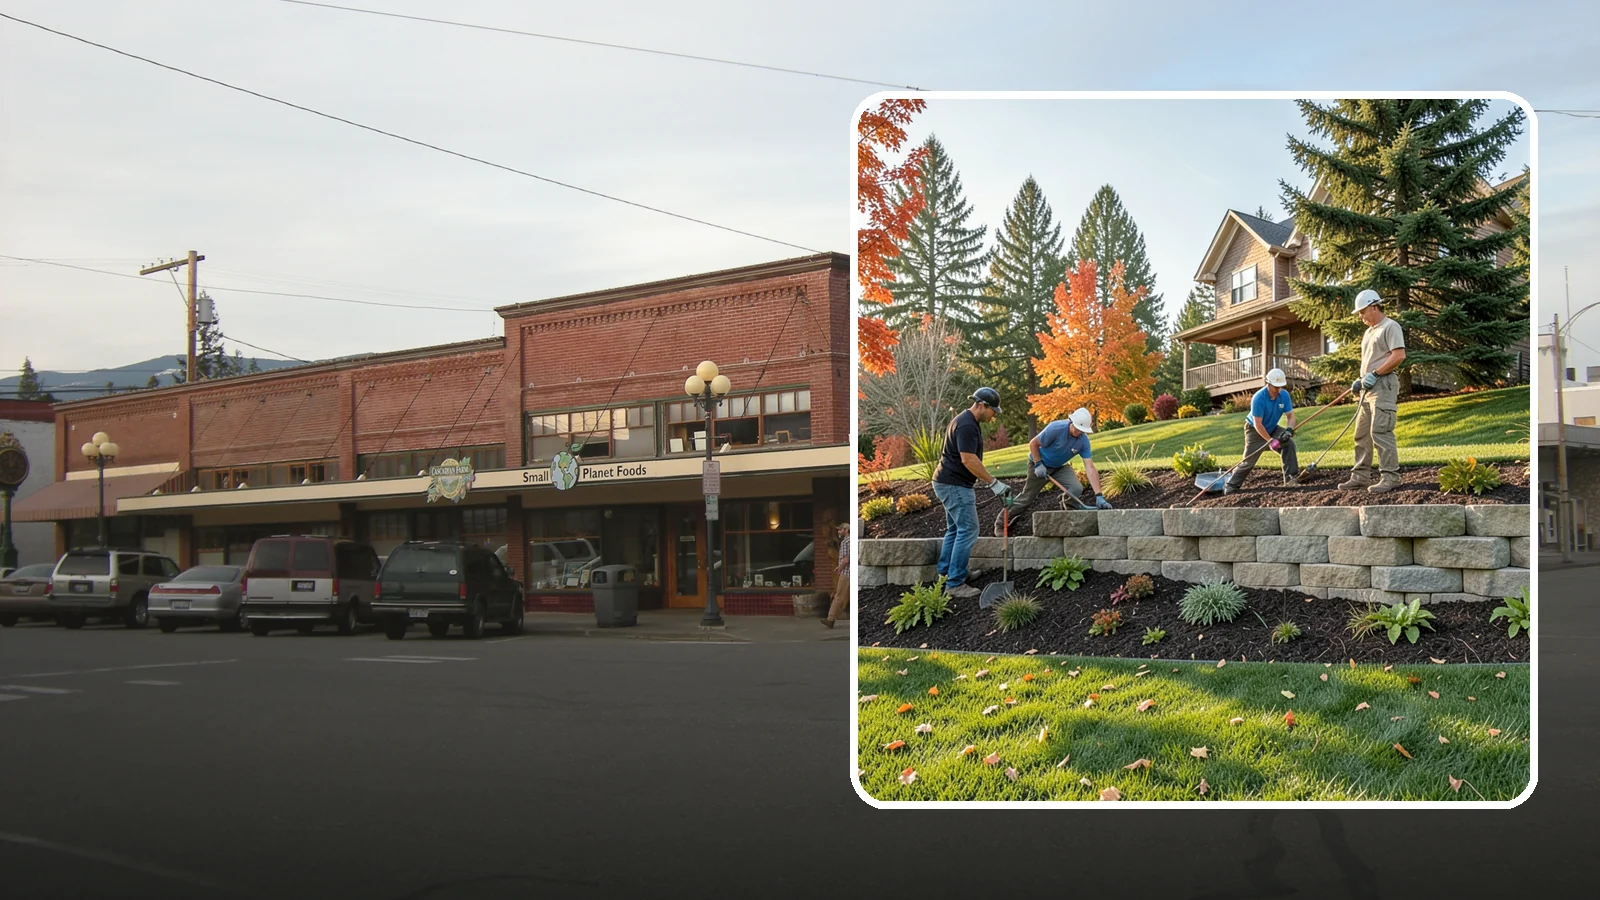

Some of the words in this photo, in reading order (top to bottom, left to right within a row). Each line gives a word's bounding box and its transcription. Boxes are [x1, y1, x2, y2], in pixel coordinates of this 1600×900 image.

[523, 471, 549, 483] Small
[582, 467, 614, 479] Planet
[616, 464, 647, 477] Foods
